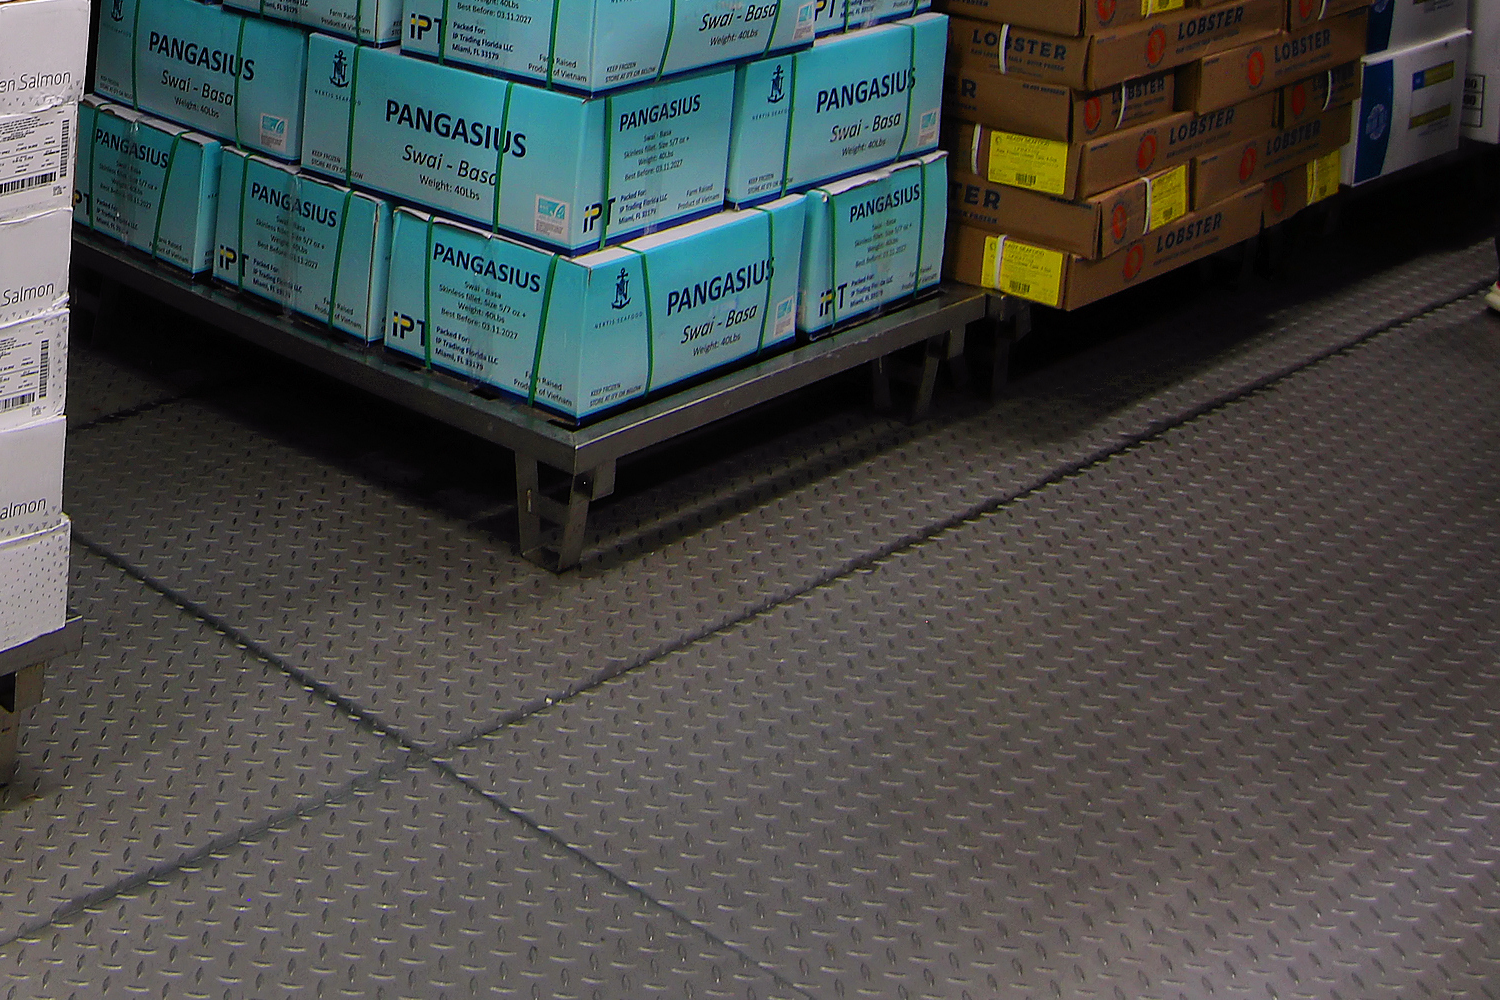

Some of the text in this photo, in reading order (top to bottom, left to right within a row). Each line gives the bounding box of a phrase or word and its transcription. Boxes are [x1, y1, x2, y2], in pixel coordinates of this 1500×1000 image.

[149, 31, 255, 81] PANGASIUS
[18, 69, 71, 90] Salmon
[816, 67, 916, 114] PANGASIUS
[386, 98, 527, 158] PANGASIUS
[619, 94, 701, 133] PANGASIUS
[1169, 108, 1235, 146] LOBSTER
[849, 185, 920, 223] PANGASIUS
[1156, 213, 1222, 254] LOBSTER
[434, 242, 541, 293] PANGASIUS
[667, 257, 774, 317] PANGASIUS
[681, 304, 758, 346] Swai Basa
